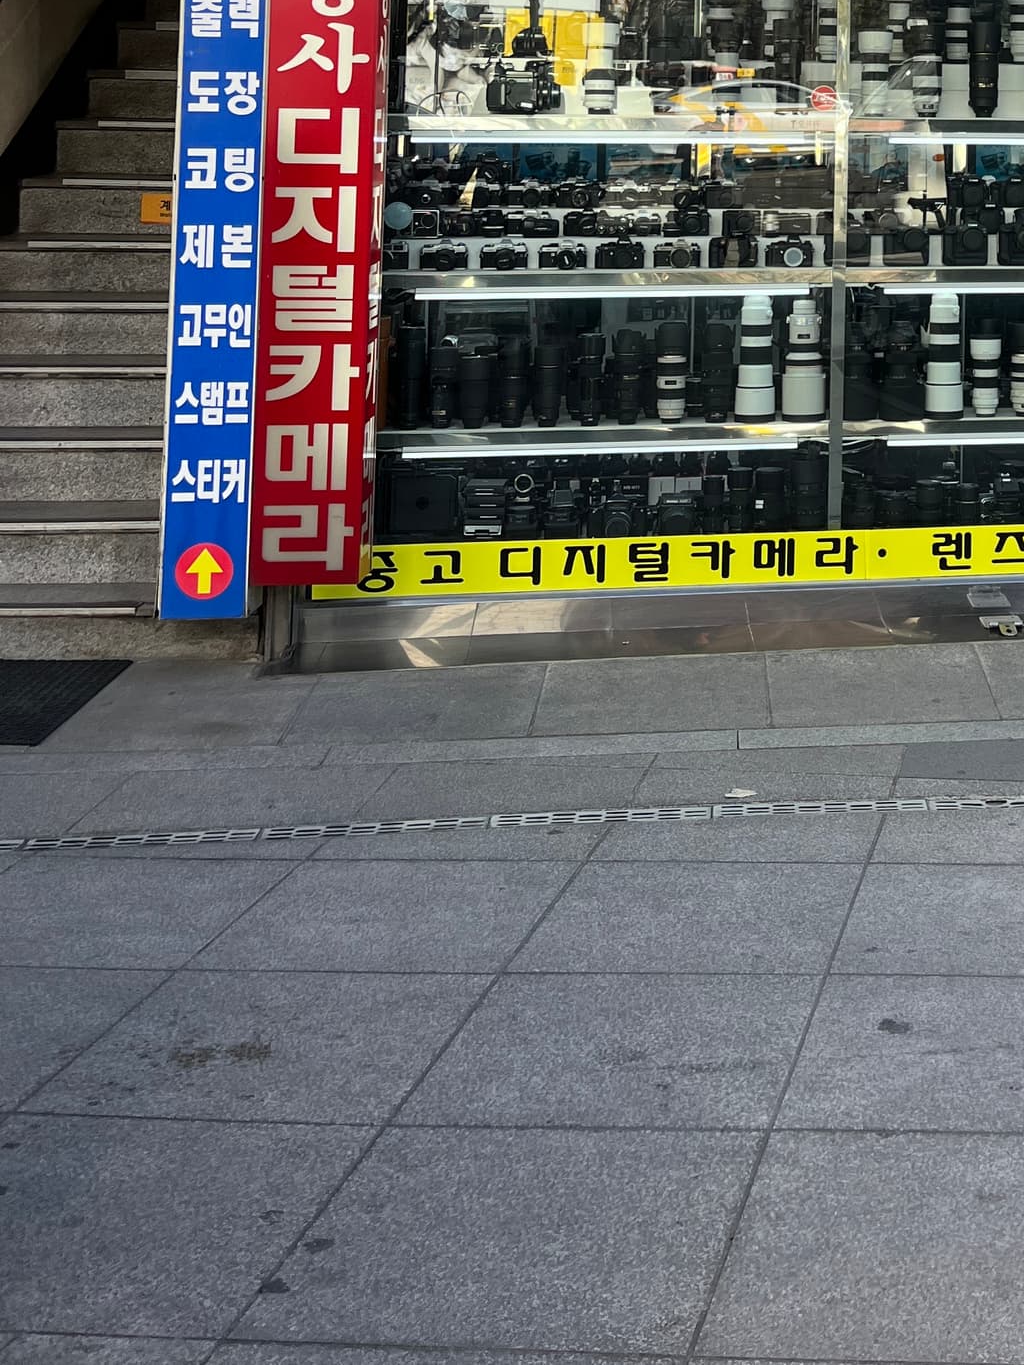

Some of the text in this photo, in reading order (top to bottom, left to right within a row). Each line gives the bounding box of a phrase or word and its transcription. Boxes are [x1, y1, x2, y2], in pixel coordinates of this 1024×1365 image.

[187, 71, 261, 116] 도장
[184, 147, 256, 193] 코팅
[179, 224, 254, 269] 제본
[177, 303, 253, 348] 고무인
[262, 108, 361, 572] 디지털카메라
[174, 381, 250, 426] 스탬프
[171, 458, 247, 504] 스티커
[356, 548, 464, 593] 중고
